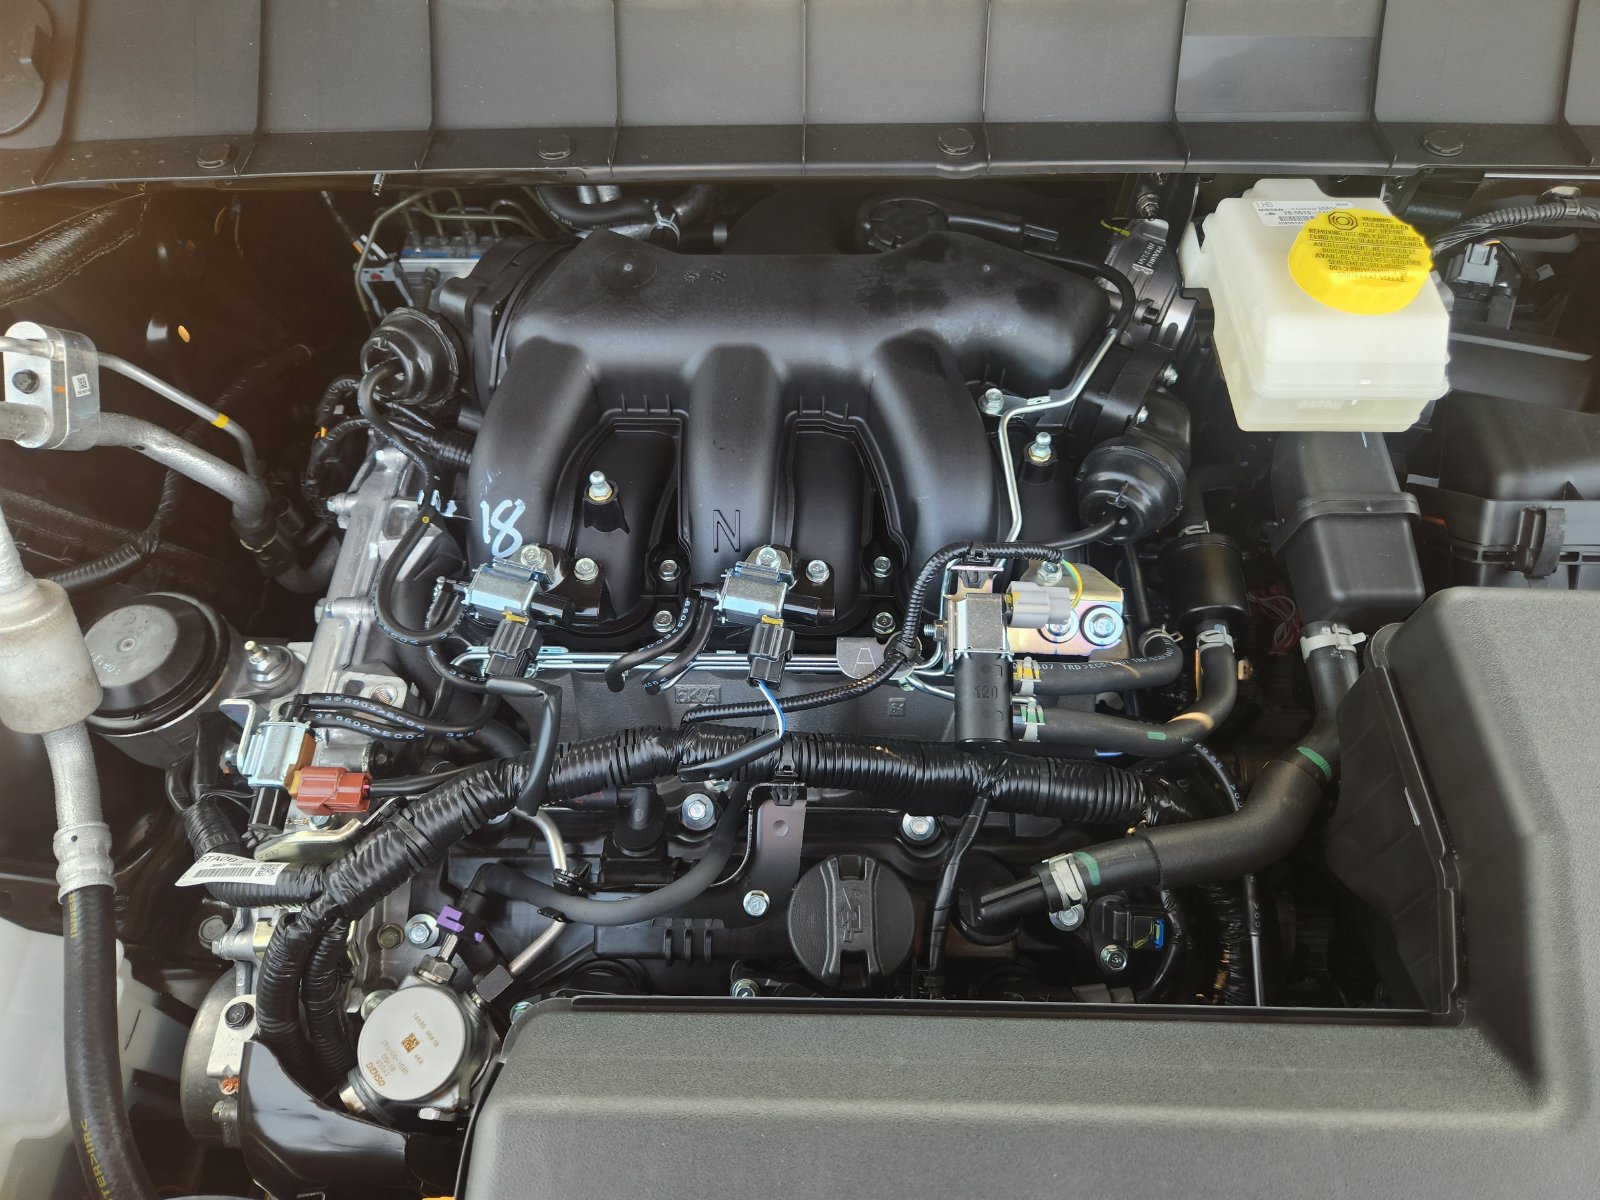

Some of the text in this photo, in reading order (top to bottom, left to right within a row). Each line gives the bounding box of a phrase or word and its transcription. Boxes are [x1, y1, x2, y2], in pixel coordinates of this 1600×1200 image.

[480, 499, 526, 559] 18
[713, 509, 740, 553] N
[853, 648, 877, 675] A
[366, 1062, 386, 1087] DENSO
[81, 1118, 113, 1200] TER>IIR<
